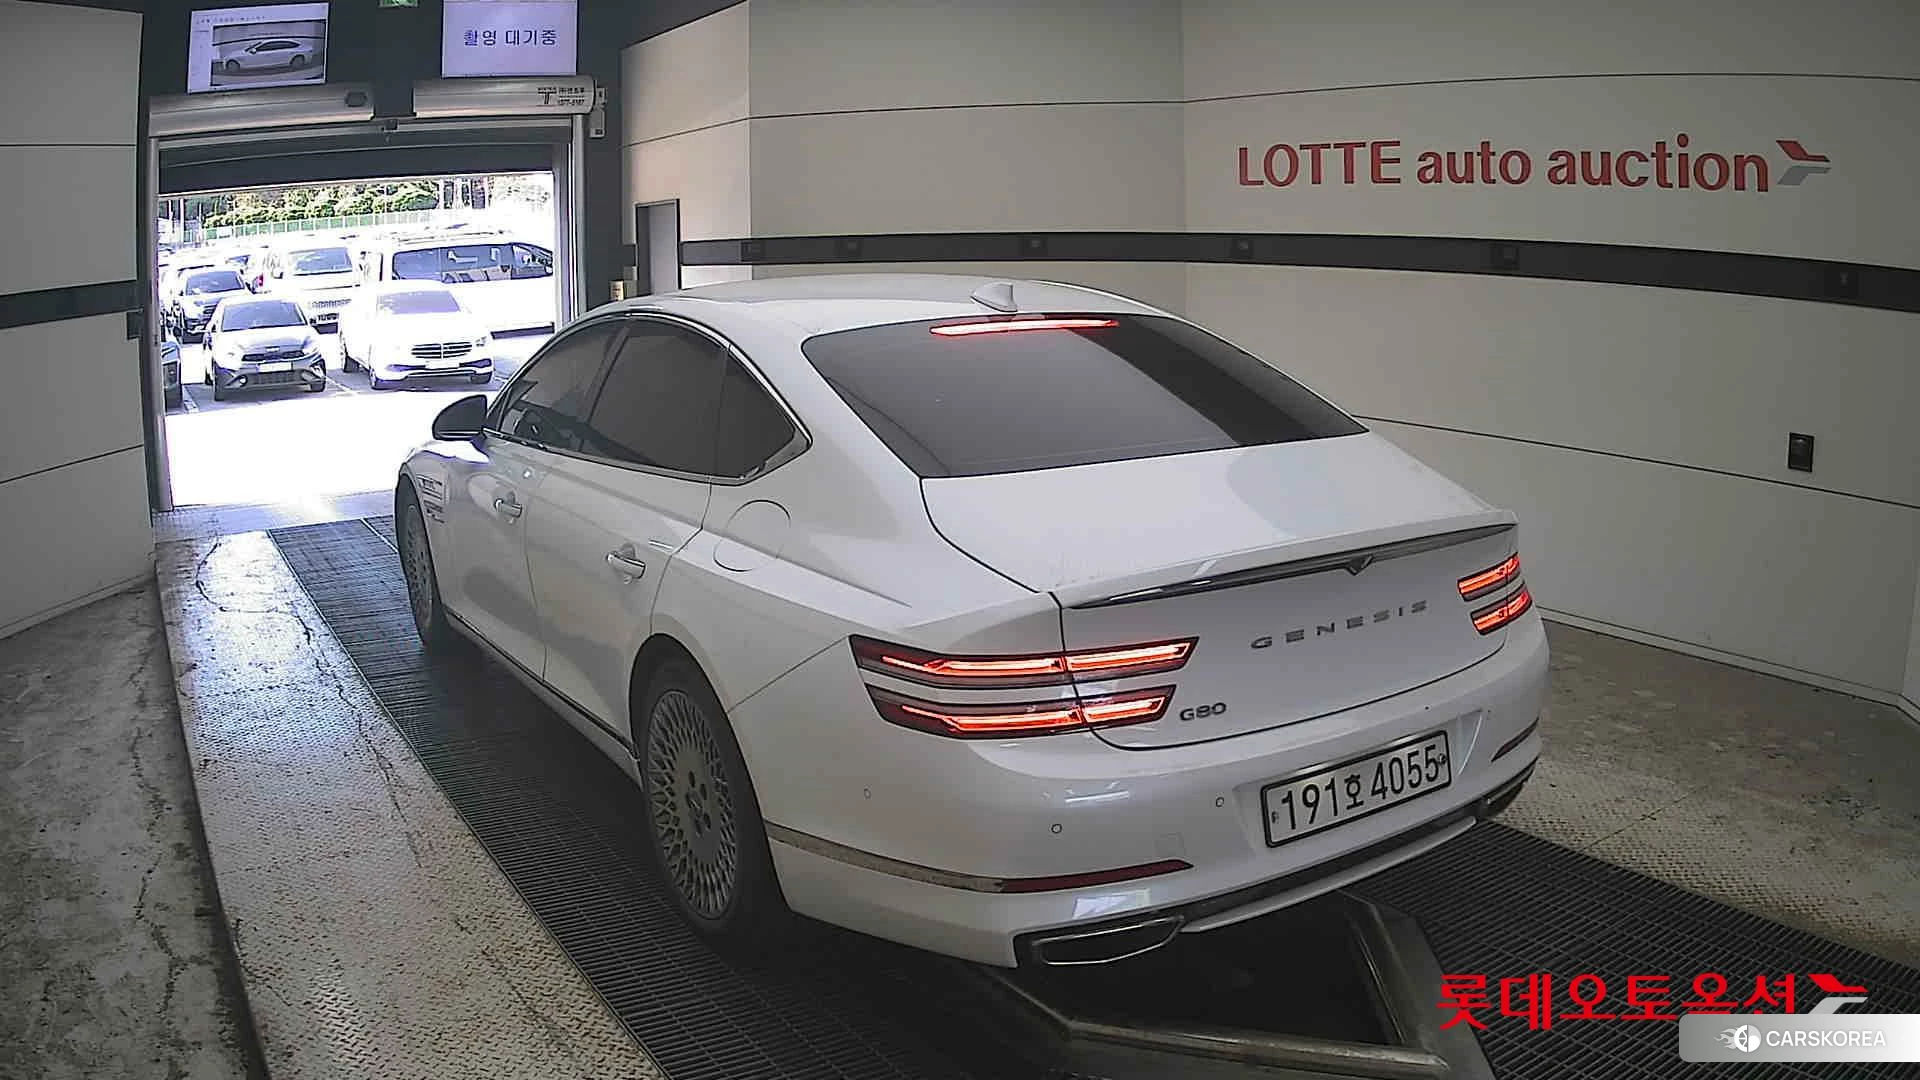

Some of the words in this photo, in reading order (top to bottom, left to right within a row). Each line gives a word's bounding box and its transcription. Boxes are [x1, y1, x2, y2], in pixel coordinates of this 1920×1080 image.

[504, 29, 558, 46] 대기중
[1238, 140, 1401, 187] LOTTE
[1417, 141, 1532, 185] auto
[1548, 134, 1769, 191] auction
[1250, 599, 1428, 649] GENESIS
[1179, 702, 1227, 721] G80
